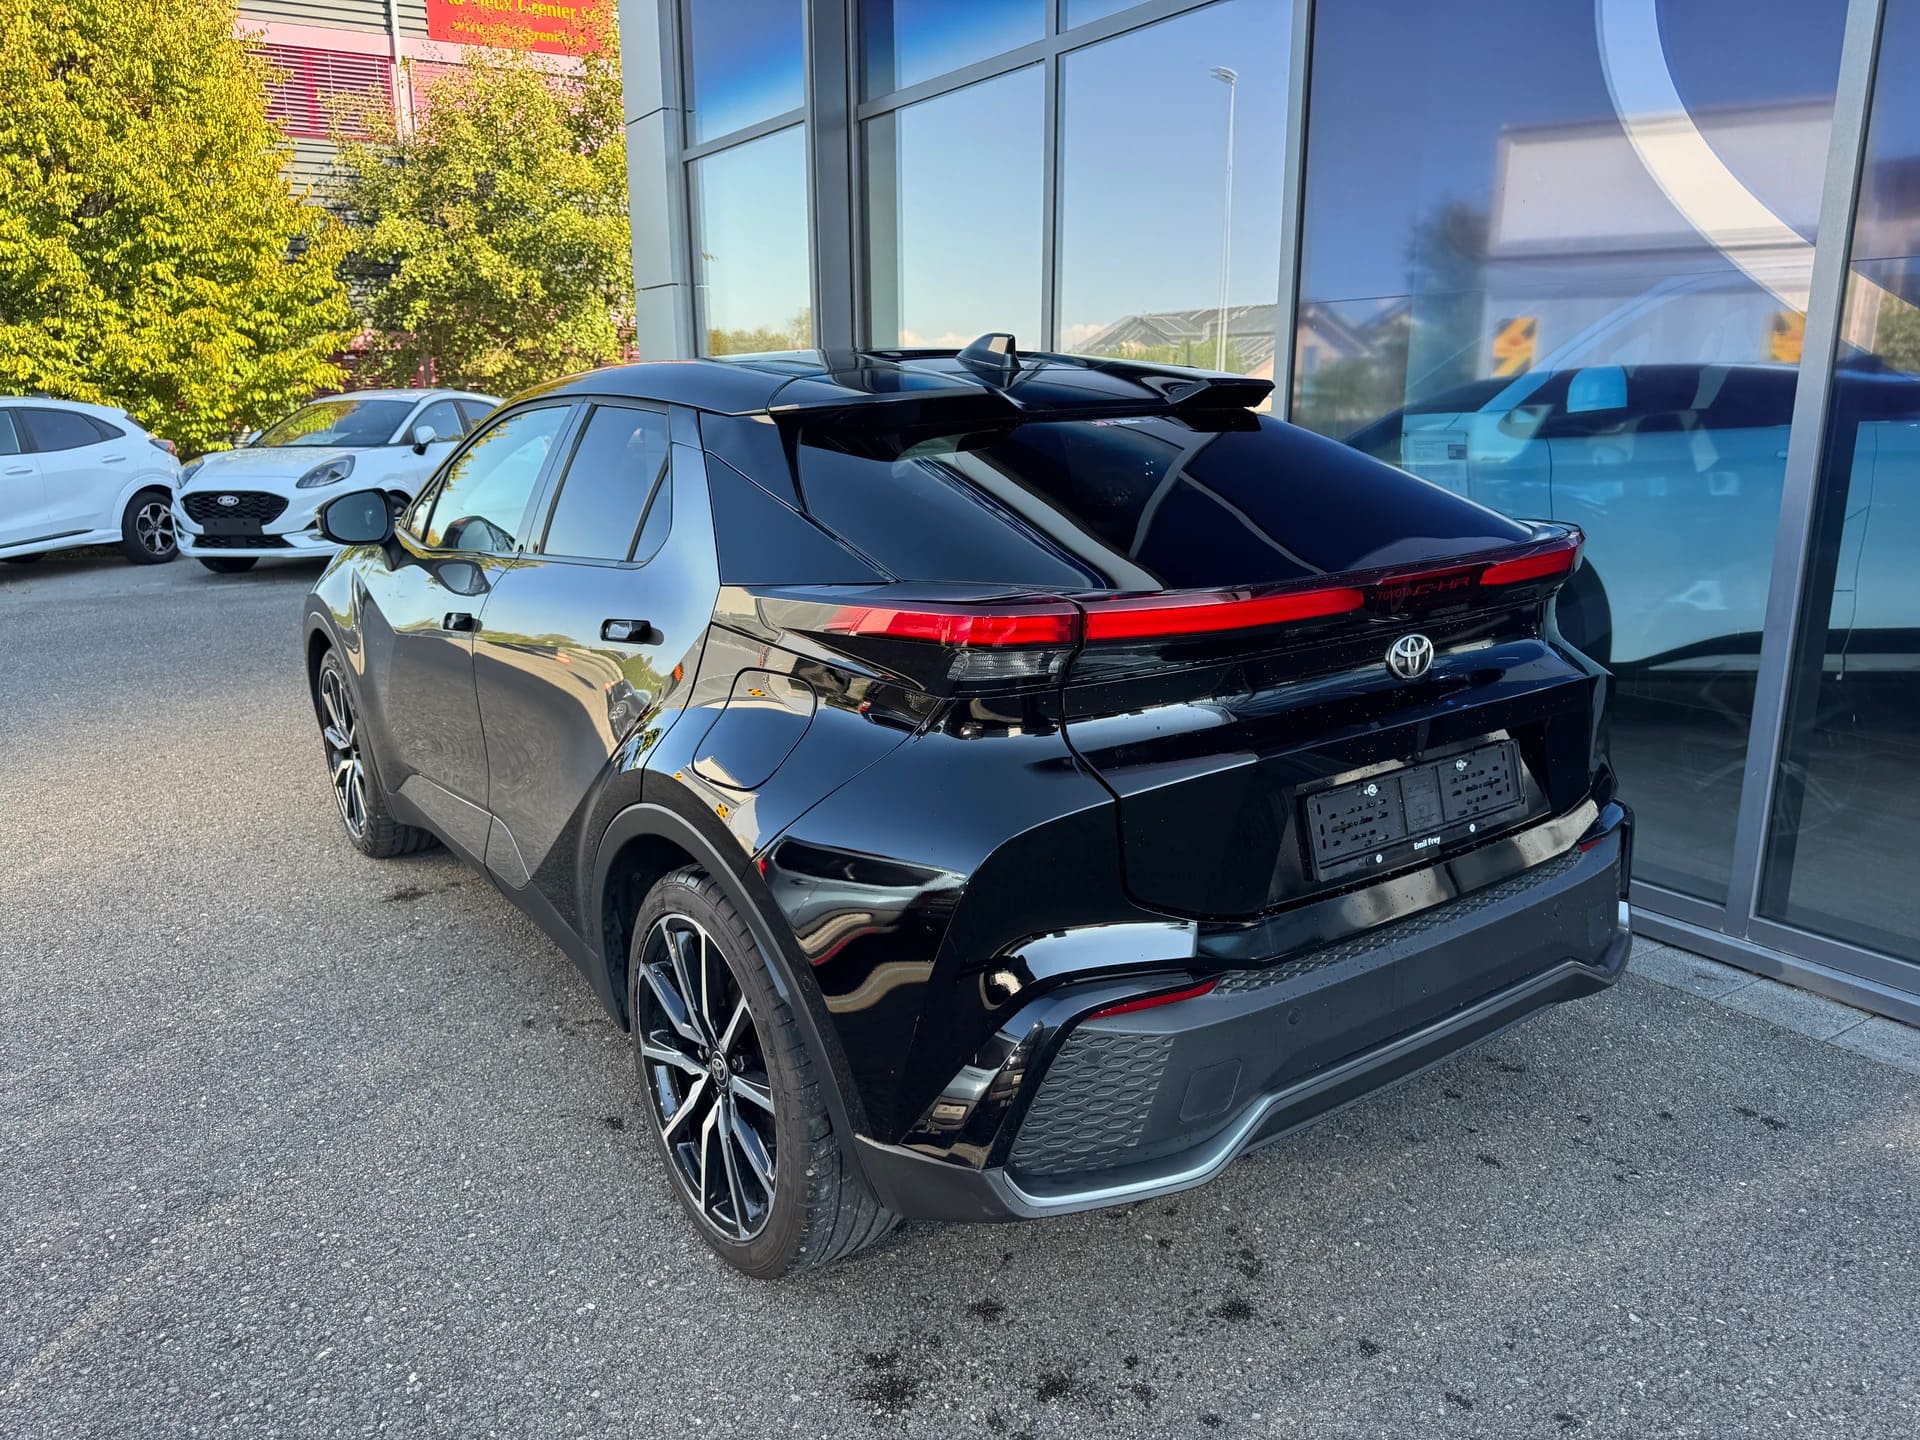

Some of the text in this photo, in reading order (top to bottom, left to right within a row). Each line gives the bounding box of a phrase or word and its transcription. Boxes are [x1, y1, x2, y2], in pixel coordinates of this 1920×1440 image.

[1376, 576, 1470, 601] TOYOTA C-HR
[1413, 836, 1441, 850] Emil Frey
